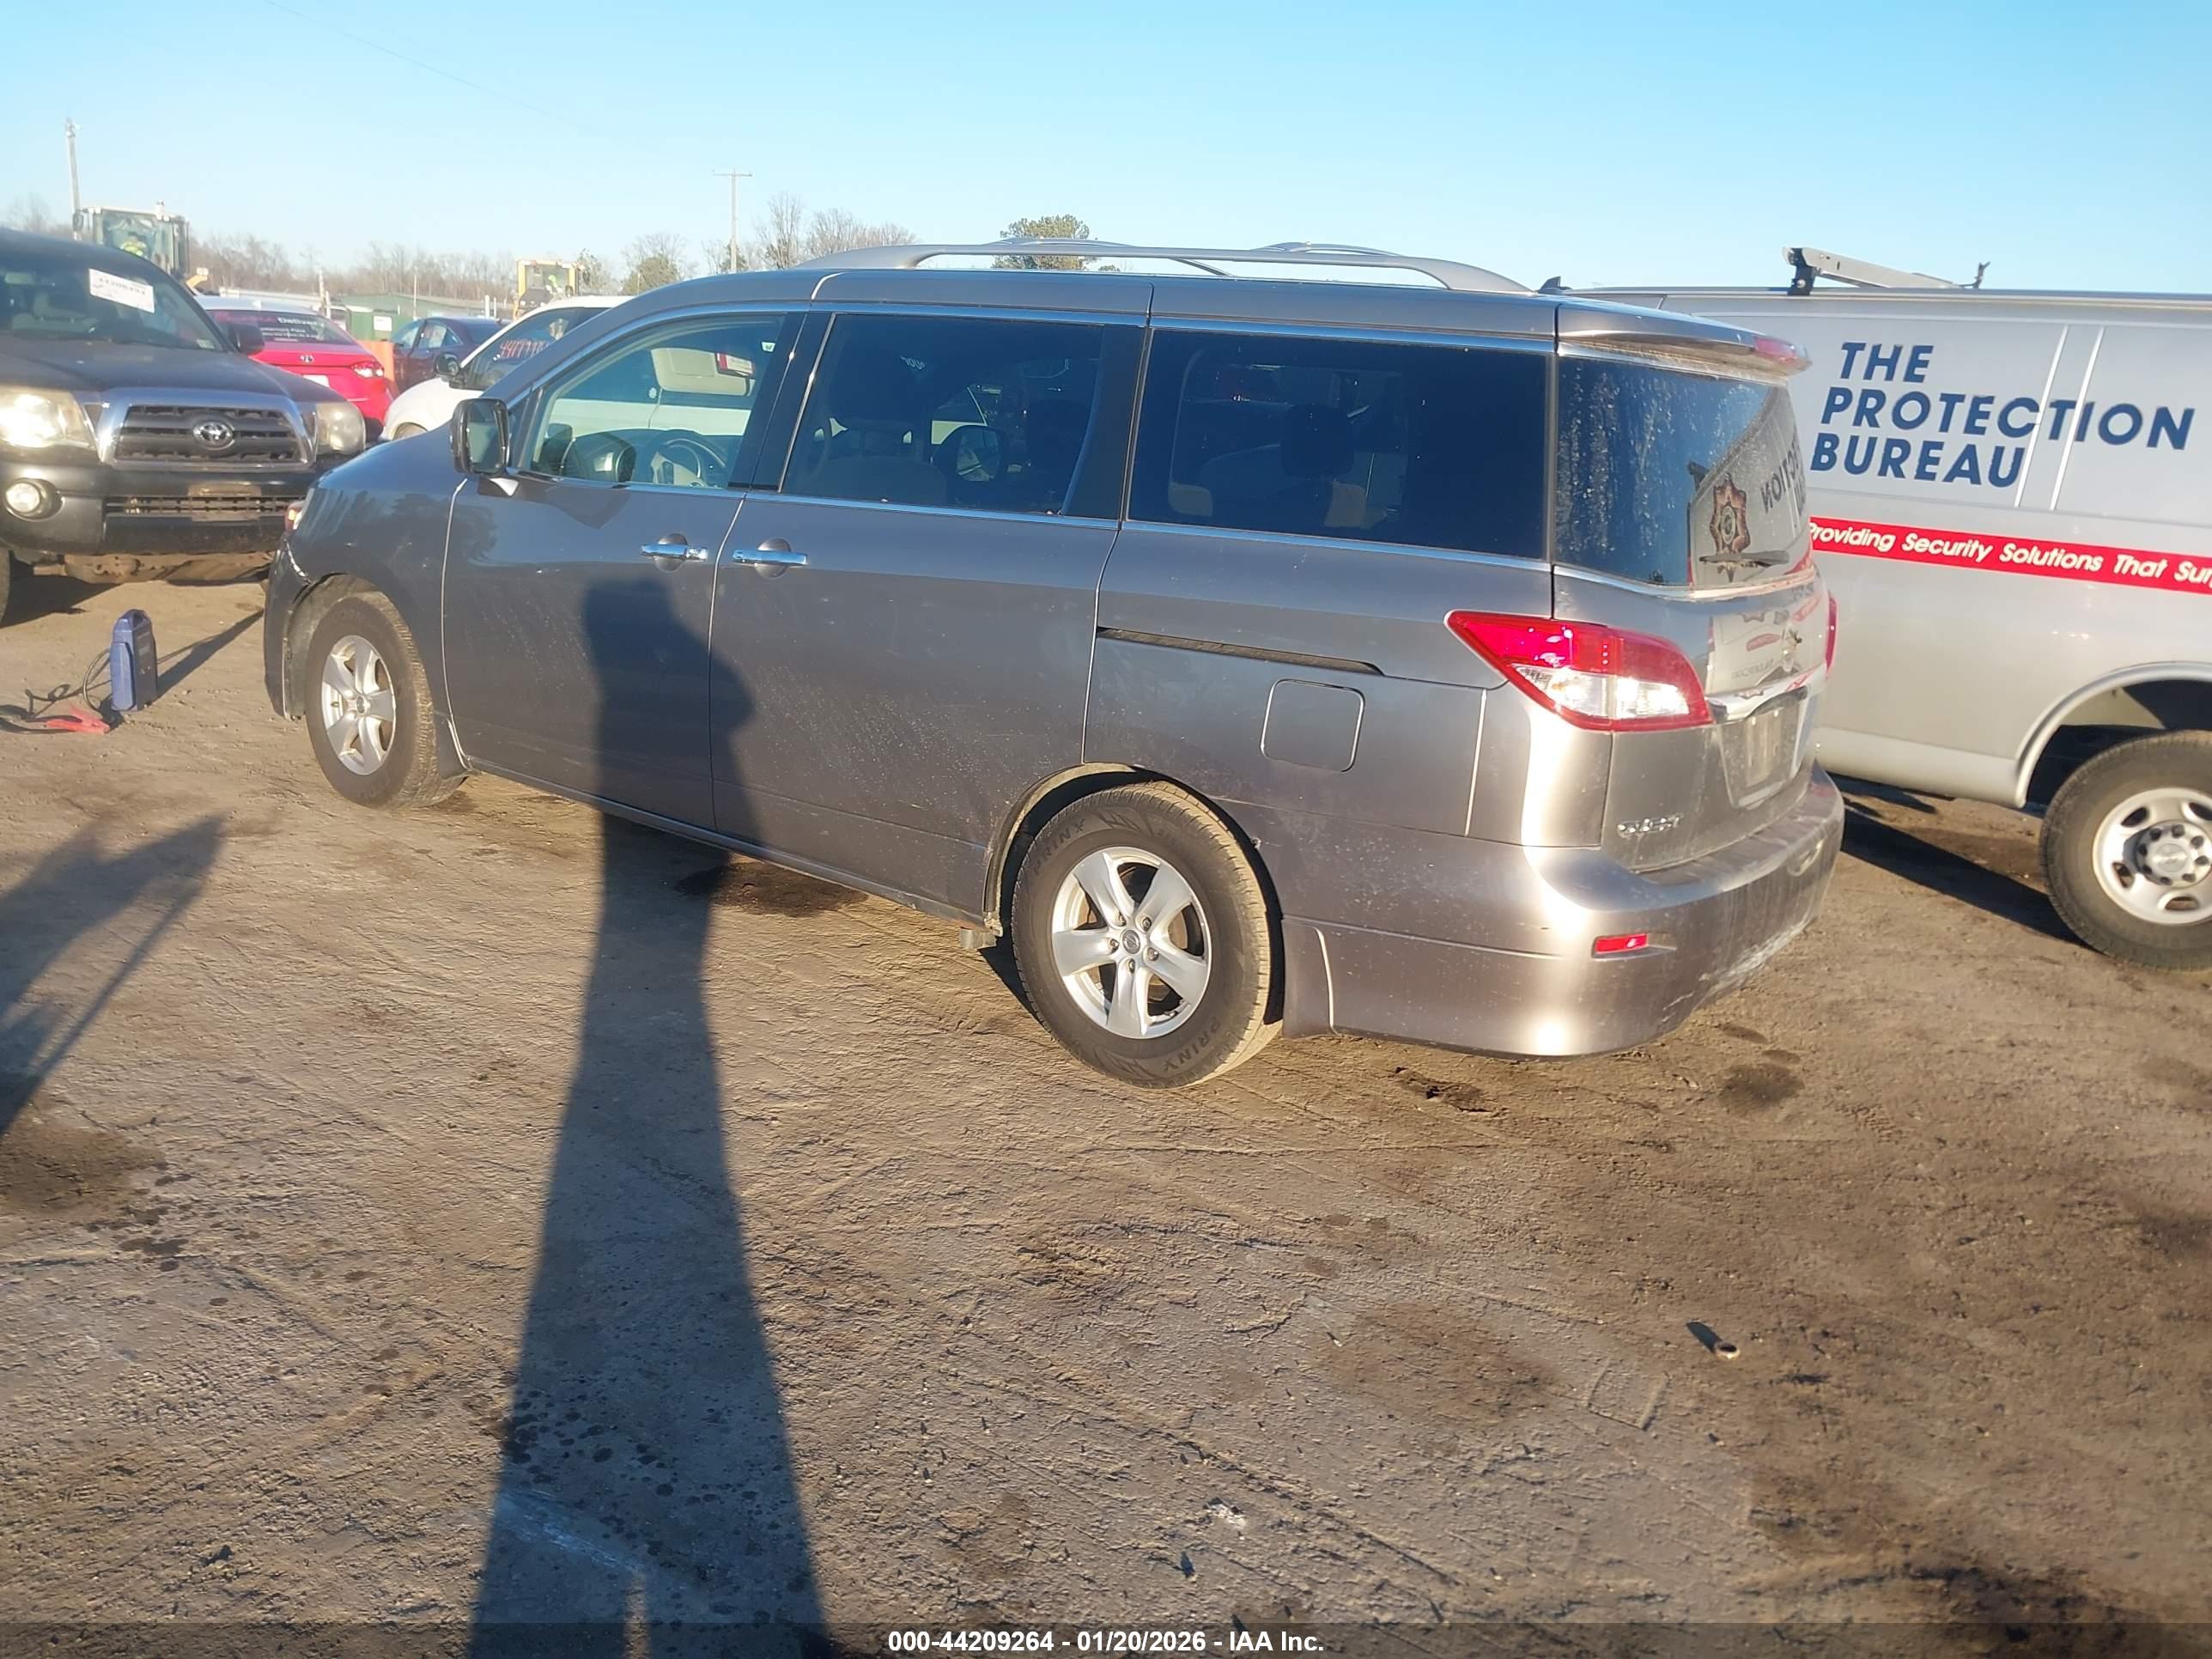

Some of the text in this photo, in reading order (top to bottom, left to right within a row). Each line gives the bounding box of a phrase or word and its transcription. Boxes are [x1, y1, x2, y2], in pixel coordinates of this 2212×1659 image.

[1840, 342, 1934, 383] THE
[1820, 386, 2196, 450] PROTECTION
[1810, 432, 2026, 488] BUREAU
[1808, 522, 2212, 589] Providing Security Solutions That Sur
